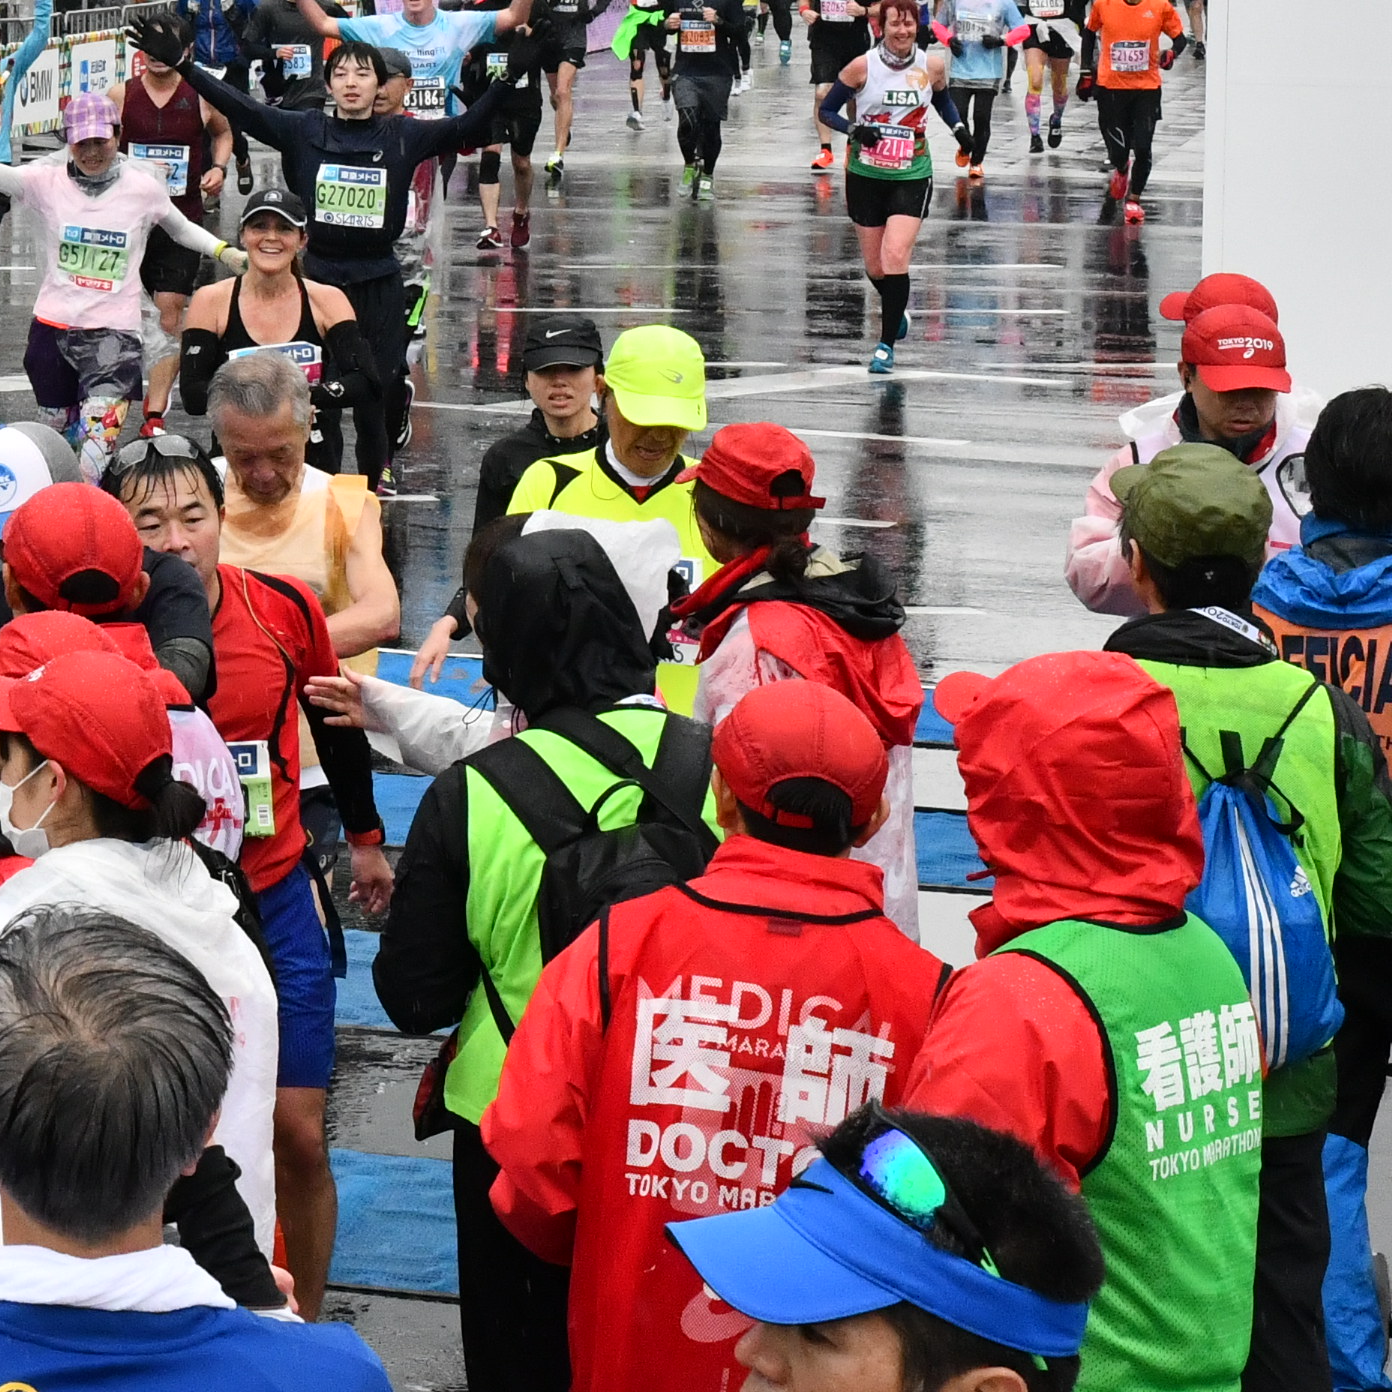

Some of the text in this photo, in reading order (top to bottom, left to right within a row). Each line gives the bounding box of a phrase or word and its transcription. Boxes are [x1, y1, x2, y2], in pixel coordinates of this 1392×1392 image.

[30, 69, 52, 103] BMW
[883, 90, 918, 105] LISA
[147, 148, 182, 157] 東京メトロ
[340, 171, 379, 181] 東京メトロ
[317, 183, 375, 209] G27020
[83, 230, 125, 245] 東京メトロ
[76, 276, 111, 290] ヤマザキ
[1217, 338, 1245, 346] TOKYO
[1245, 337, 1273, 351] 2019
[629, 998, 895, 1126] 医師
[1134, 1001, 1261, 1112] 看護師
[1144, 1091, 1261, 1151] NURSE
[1149, 1127, 1262, 1181] TOKYO MARATHON
[624, 1172, 710, 1204] TOKYO
